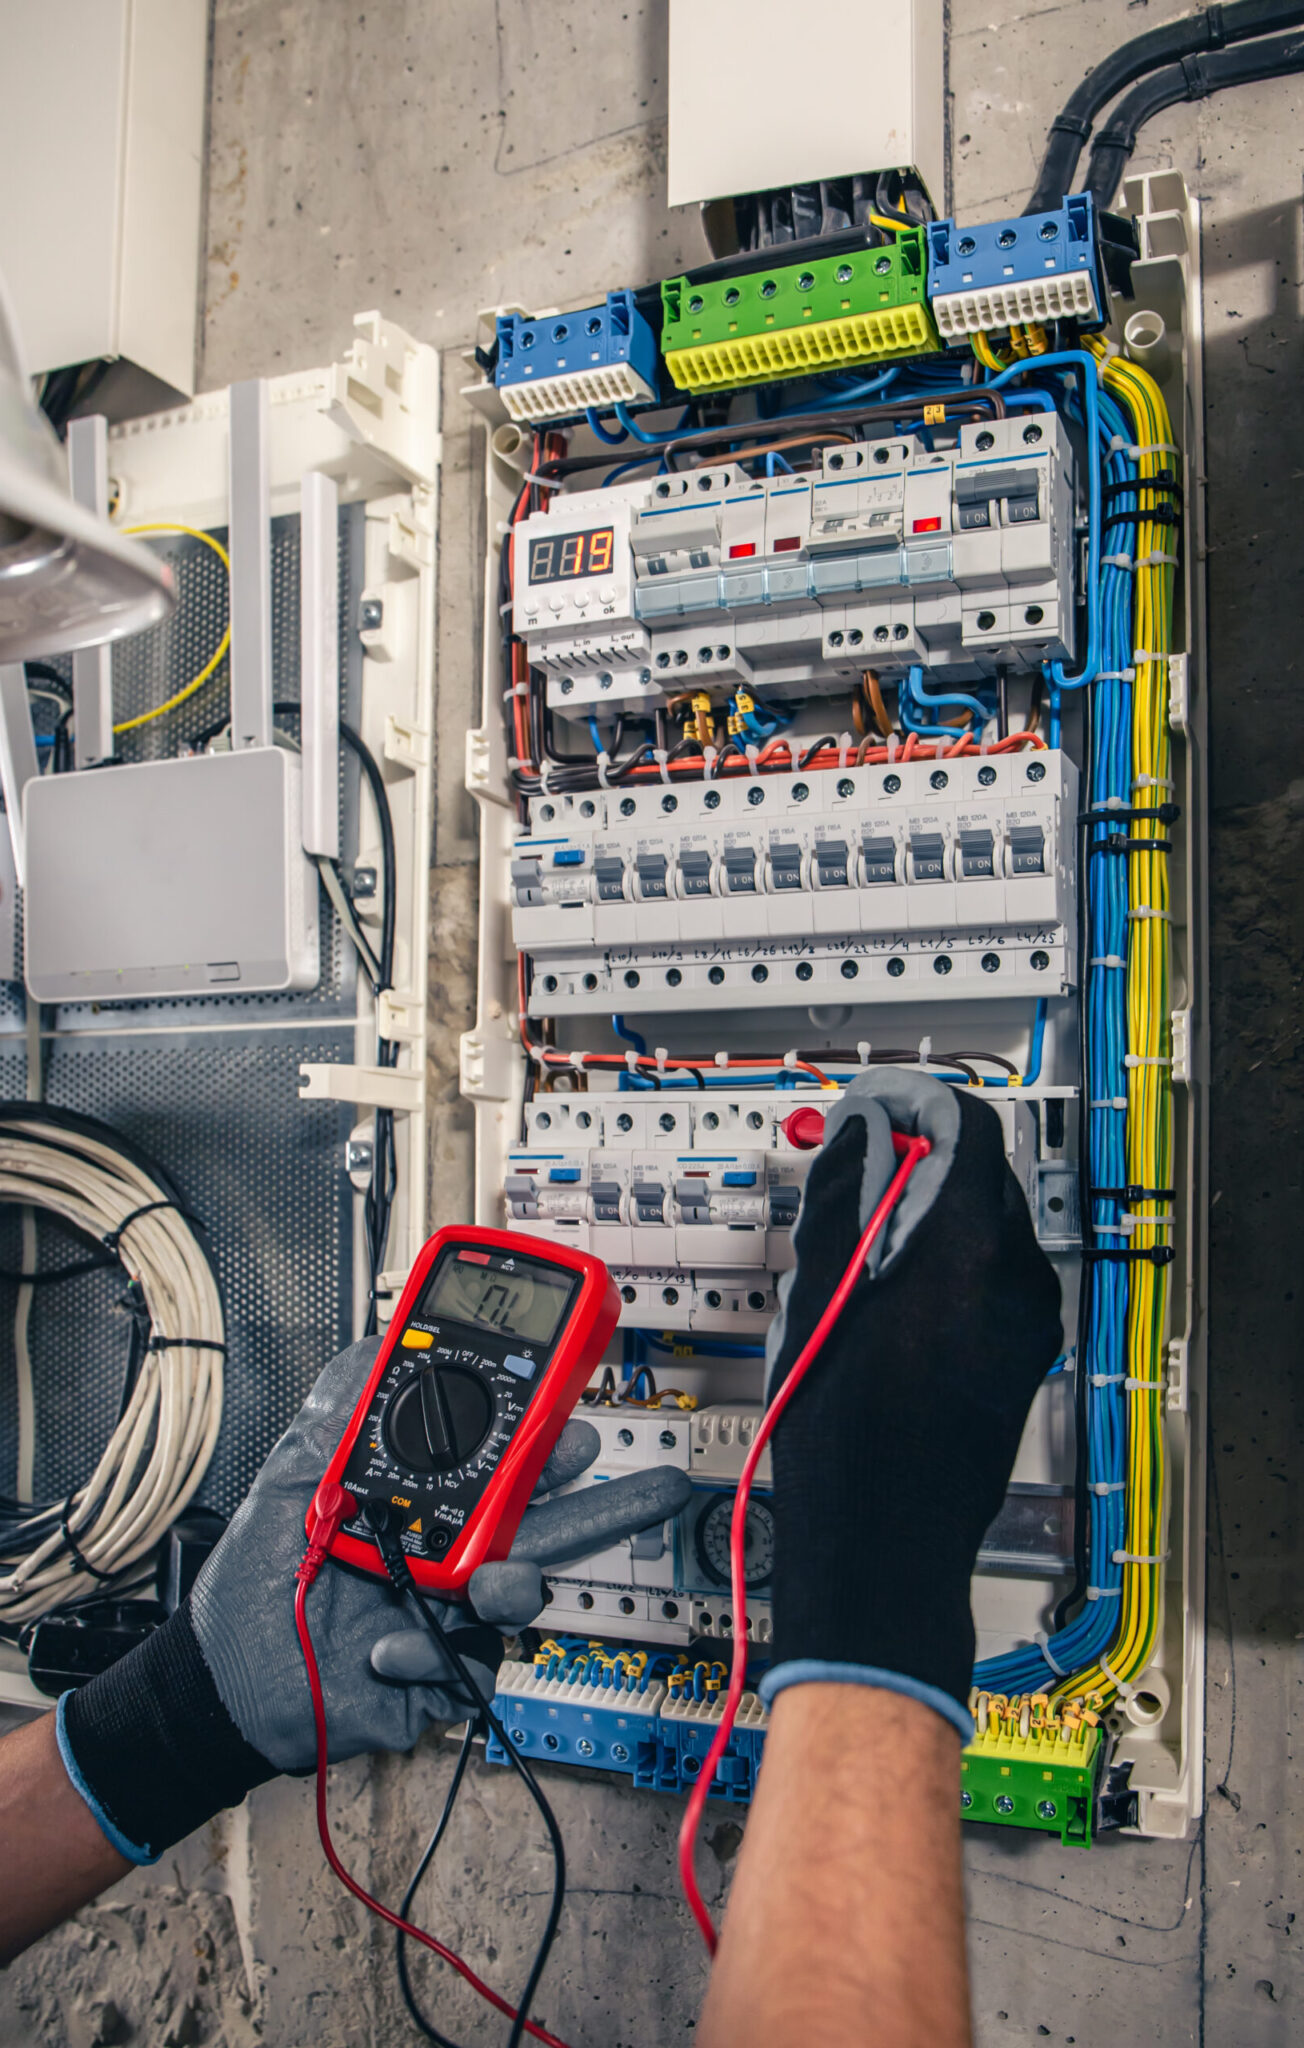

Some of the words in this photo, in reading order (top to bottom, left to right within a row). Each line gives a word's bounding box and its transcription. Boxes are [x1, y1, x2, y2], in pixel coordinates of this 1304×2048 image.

[572, 531, 613, 574] 19
[604, 606, 615, 614] ok
[620, 632, 635, 642] out
[977, 860, 990, 869] ON
[1027, 857, 1040, 865] ON
[880, 867, 893, 875] ON
[928, 864, 941, 872] ON
[501, 1263, 515, 1272] NCV
[411, 1320, 440, 1334] HOLD/SEL
[437, 1346, 452, 1355] 200M
[504, 1413, 516, 1421] 200
[498, 1433, 510, 1441] 600
[486, 1452, 498, 1461] 600
[387, 1472, 400, 1480] 20m
[466, 1470, 478, 1478] 200
[402, 1479, 418, 1489] 200m
[444, 1480, 459, 1488] NCV
[391, 1496, 412, 1508] COM
